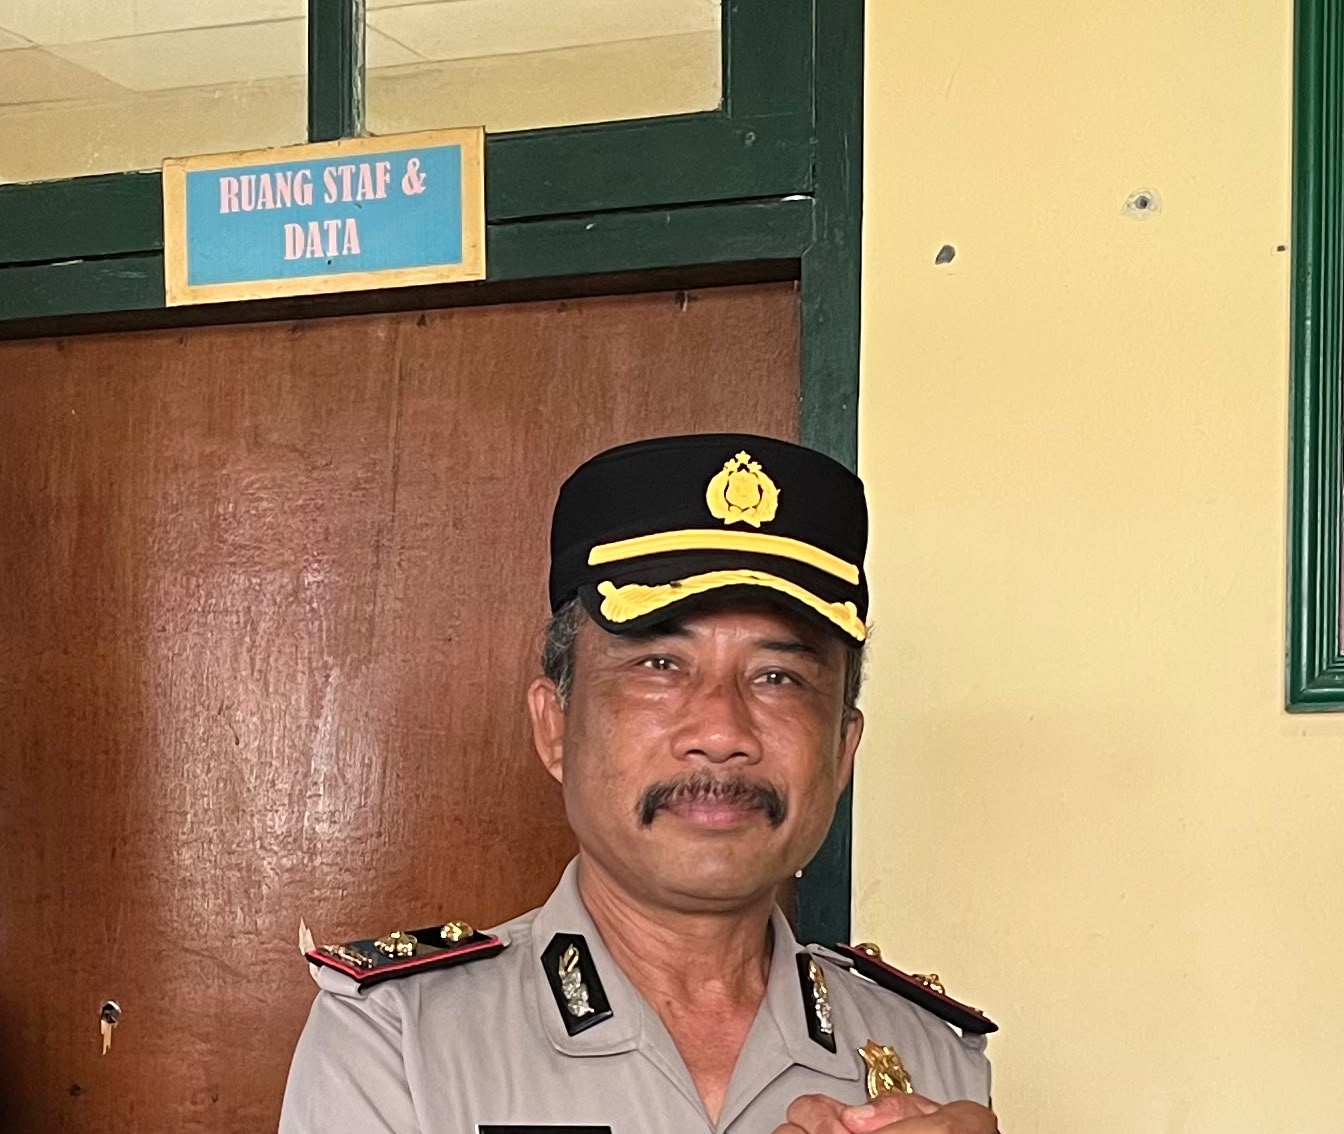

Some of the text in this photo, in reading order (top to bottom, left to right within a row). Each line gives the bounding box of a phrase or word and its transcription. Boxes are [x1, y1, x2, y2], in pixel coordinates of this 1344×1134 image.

[219, 158, 426, 214] RUANG STAF &
[284, 218, 360, 260] DATA
